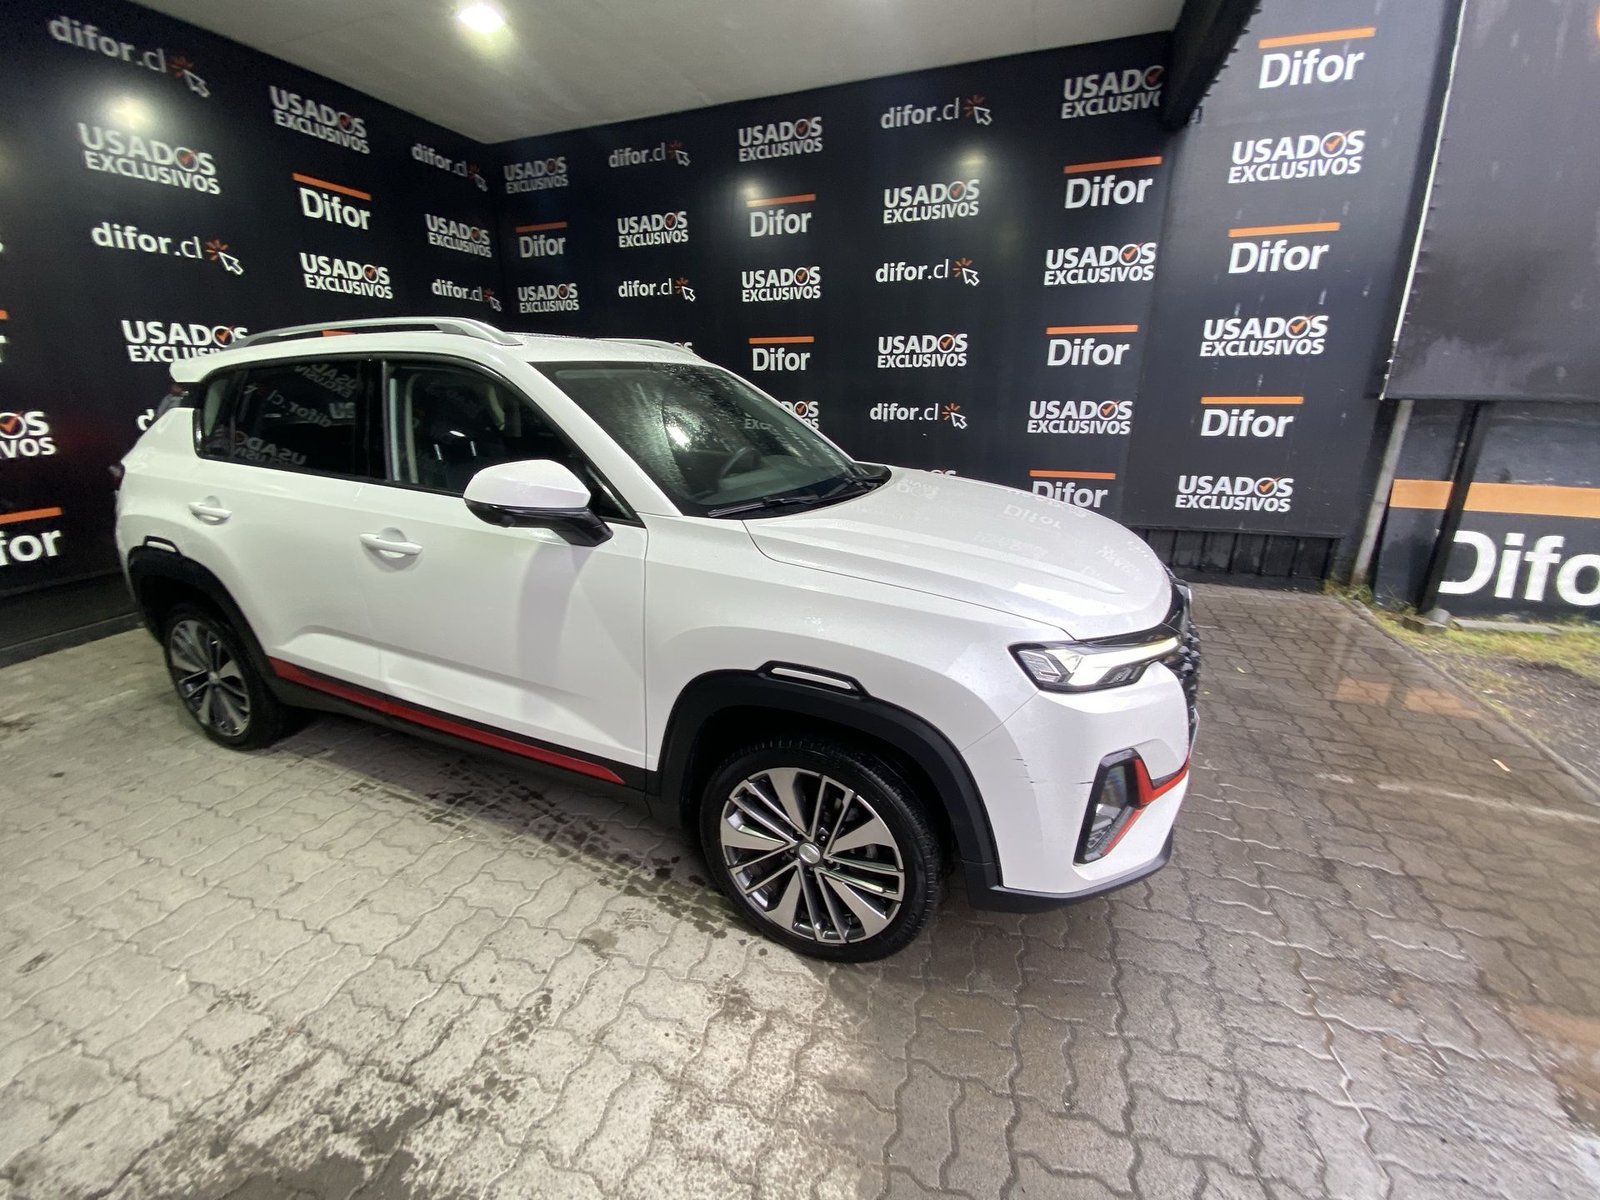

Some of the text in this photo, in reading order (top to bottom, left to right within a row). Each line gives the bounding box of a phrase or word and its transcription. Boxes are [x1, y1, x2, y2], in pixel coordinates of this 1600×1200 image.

[50, 16, 166, 73] difor.cl
[1258, 48, 1365, 89] Difor
[1064, 65, 1165, 101] USADO
[269, 85, 367, 138] USADOS
[880, 98, 959, 129] difor.cl
[273, 109, 370, 154] EXCLUSIVOS
[738, 116, 822, 147] USADOS
[78, 123, 216, 175] USADOS
[411, 143, 468, 177] difor.cl
[609, 143, 666, 167] difor.cl
[739, 137, 823, 162] EXCLUSIVOS
[1231, 130, 1366, 165] USADOS
[85, 150, 221, 195] EXCLUSIVOS
[504, 156, 566, 181] USADOS
[1228, 155, 1362, 184] EXCLUSIVOS
[506, 174, 568, 194] EXCLUSIVOS
[884, 179, 980, 207] USADOS
[1064, 175, 1153, 209] Difor
[299, 187, 371, 230] Difor
[883, 201, 979, 224] EXCLUSIVOS
[425, 214, 490, 245] USADOS
[617, 211, 688, 234] USADOS
[750, 209, 811, 237] Difor
[91, 222, 203, 259] difor.cl
[428, 232, 492, 258] EXCLUSIVOS
[519, 236, 566, 258] Difor
[618, 228, 689, 248] EXCLUSIVOS
[300, 252, 390, 285] USADOS
[1045, 242, 1157, 269] USADOS
[1228, 240, 1330, 274] Difor
[741, 266, 821, 288] USADOS
[875, 259, 949, 282] difor.cl
[1043, 265, 1155, 286] EXCLUSIVOS
[304, 273, 393, 299] EXCLUSIVOS
[431, 279, 483, 301] difor.cl
[517, 283, 578, 301] USADOS
[618, 278, 672, 297] difor.cl
[742, 285, 821, 302] EXCLUSIVOS
[519, 299, 579, 313] EXCLUSIVOS
[1203, 315, 1329, 341] USADOS
[878, 334, 968, 354] USADOS
[1047, 338, 1130, 366] Difor
[1199, 338, 1325, 357] EXCLUSIVOS
[752, 348, 810, 371] Difor
[877, 353, 967, 368] EXCLUSIVOS
[870, 403, 938, 421] difor.cl
[1029, 400, 1133, 420] USADOS
[1200, 408, 1294, 438] Difor
[1026, 420, 1131, 435] EXCLUSIVOS
[1032, 480, 1108, 508] Difor
[1177, 475, 1294, 498] USADOS
[1175, 494, 1291, 512] EXCLUSIVOS
[0, 530, 62, 566] for
[1436, 529, 1600, 606] Difo
